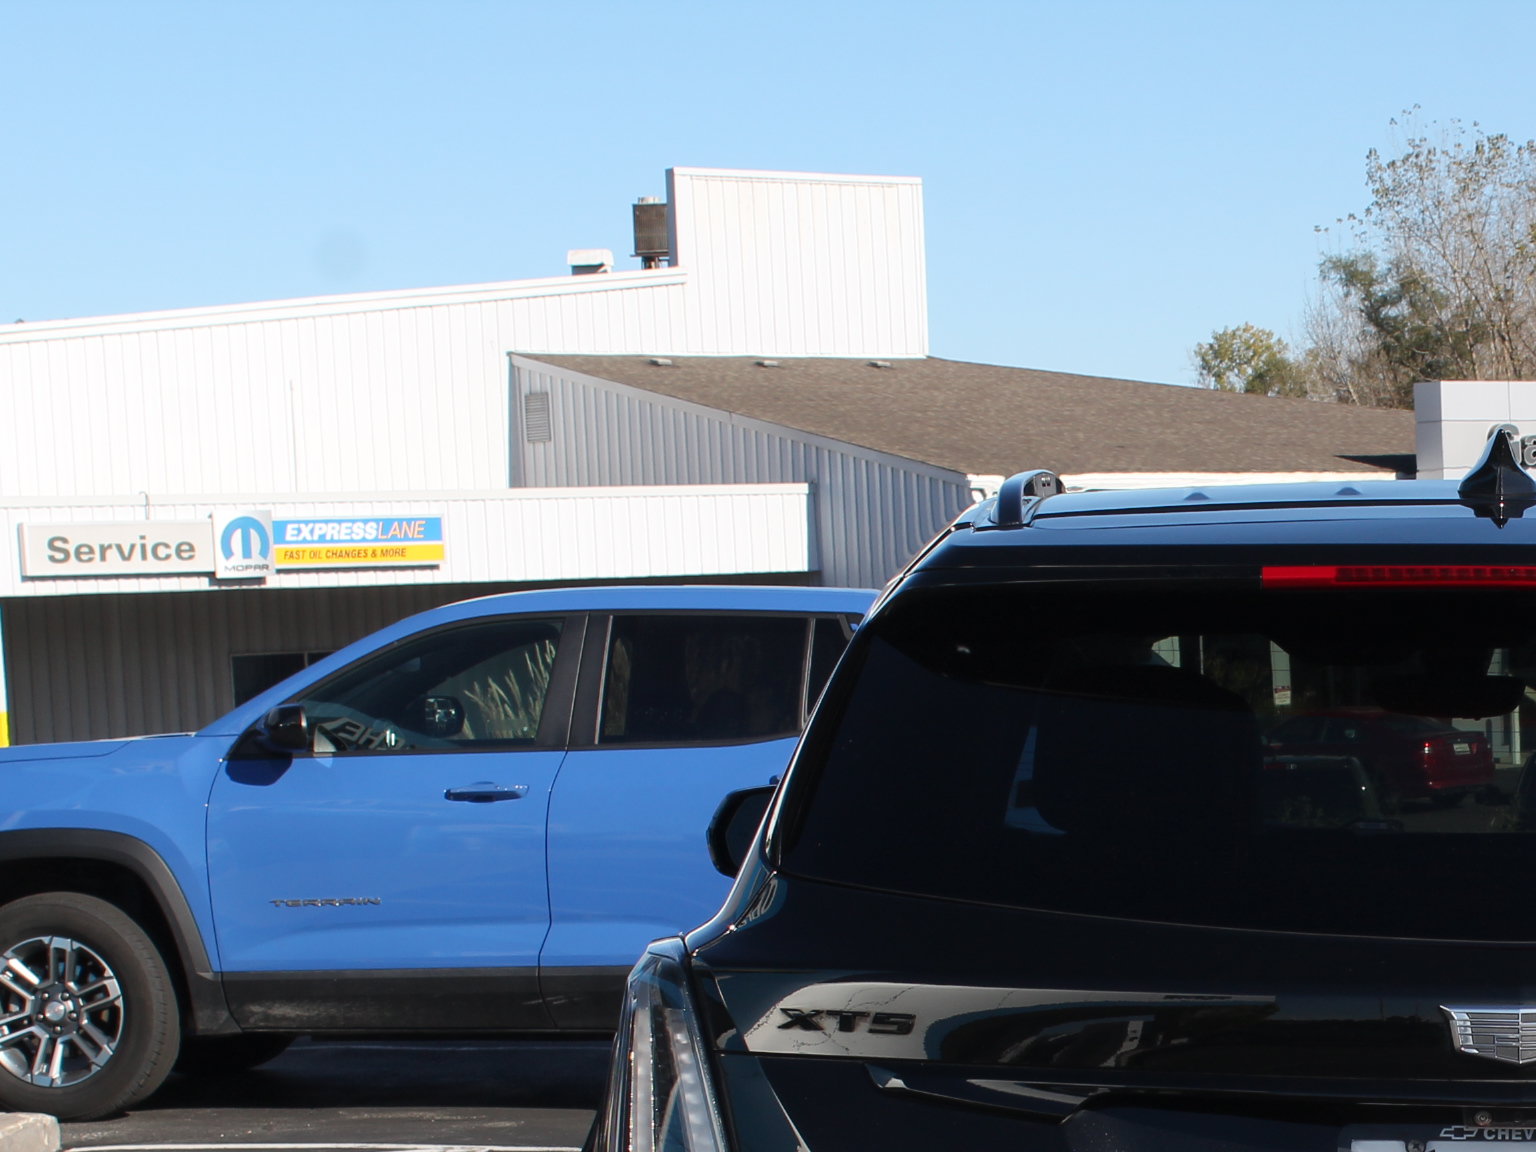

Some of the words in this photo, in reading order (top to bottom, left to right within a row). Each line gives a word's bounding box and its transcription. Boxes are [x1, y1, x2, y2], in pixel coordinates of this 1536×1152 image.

[47, 535, 196, 564] Service
[284, 549, 306, 560] FAST
[309, 549, 323, 559] OIL
[325, 548, 369, 559] CHANGES
[371, 548, 377, 558] &
[380, 548, 406, 557] MORE
[224, 563, 270, 572] MOPAR
[268, 897, 382, 907] TERRAIN
